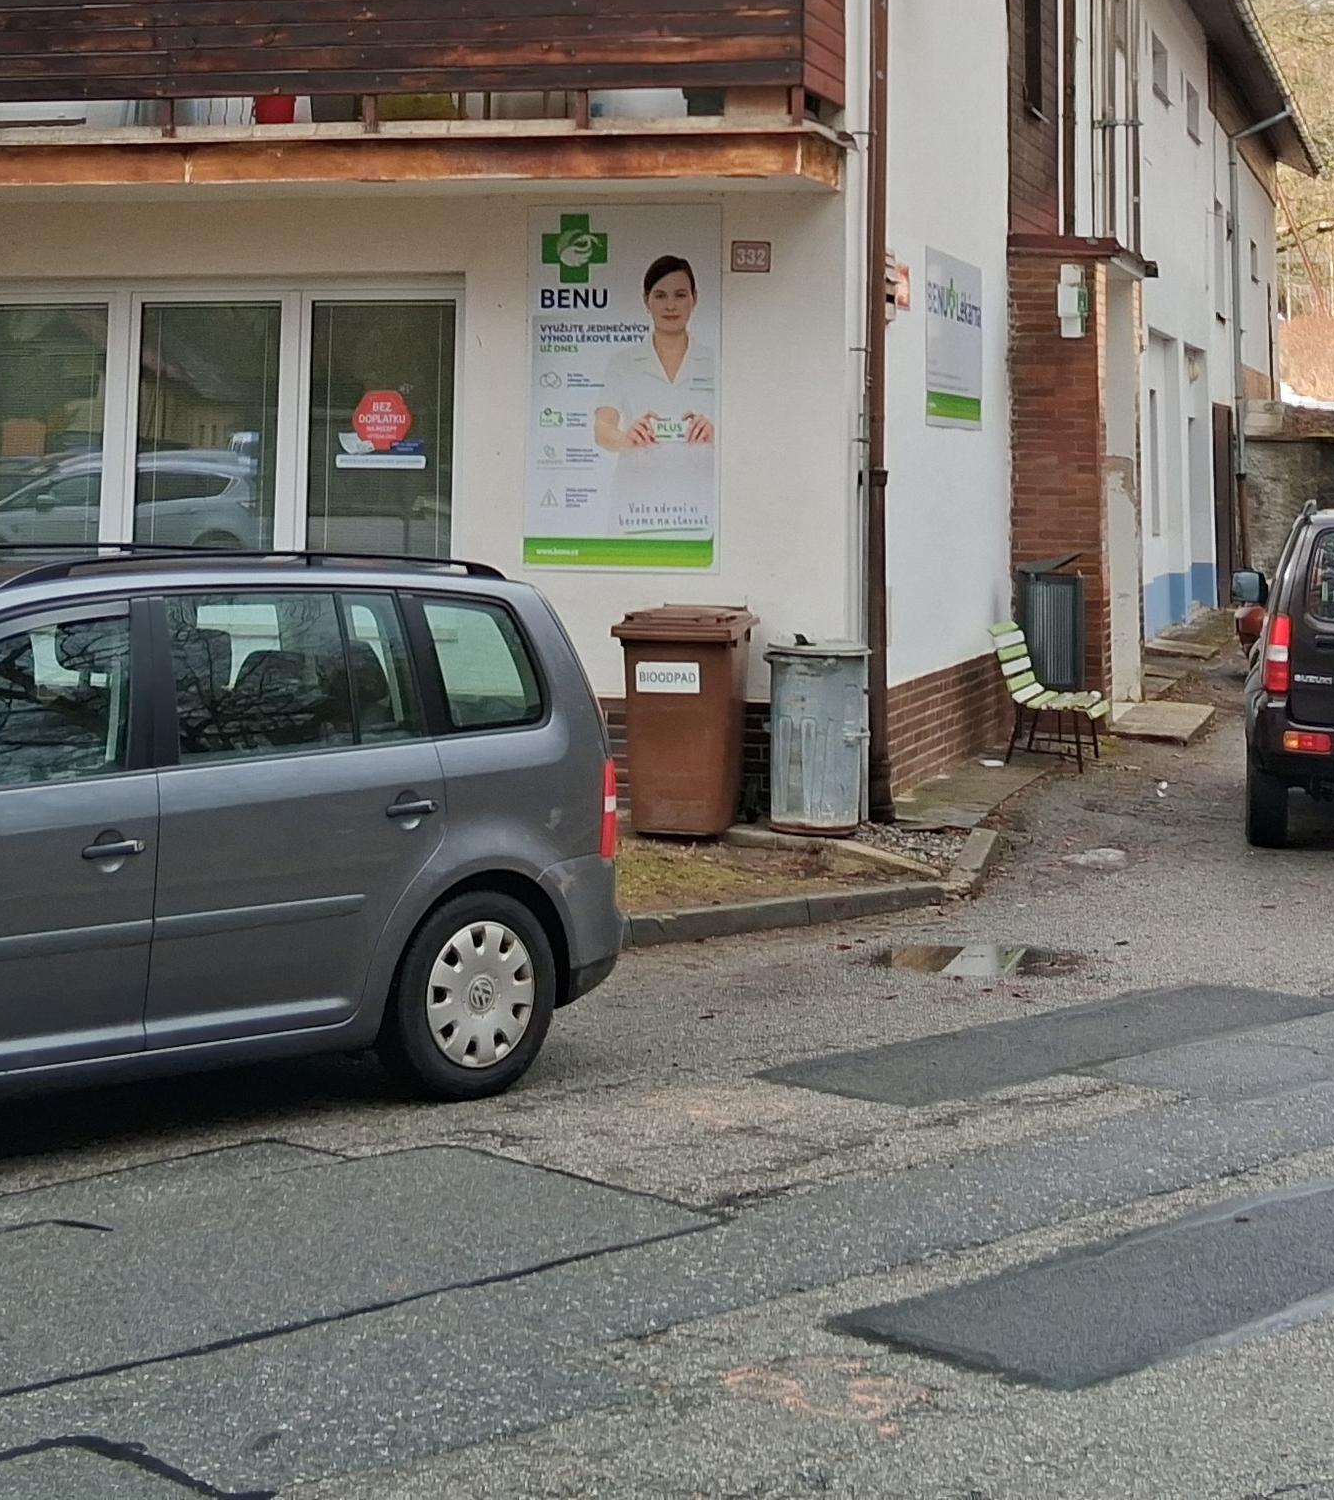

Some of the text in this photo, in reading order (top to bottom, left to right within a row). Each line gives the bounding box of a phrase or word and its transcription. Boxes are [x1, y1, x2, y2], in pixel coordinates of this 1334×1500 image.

[737, 248, 766, 266] 332
[540, 288, 609, 309] BENU
[613, 334, 646, 343] KARTY
[554, 344, 578, 353] DNES
[372, 402, 393, 412] BEZ
[358, 414, 406, 424] DOPLATKU
[657, 422, 683, 432] PLUS
